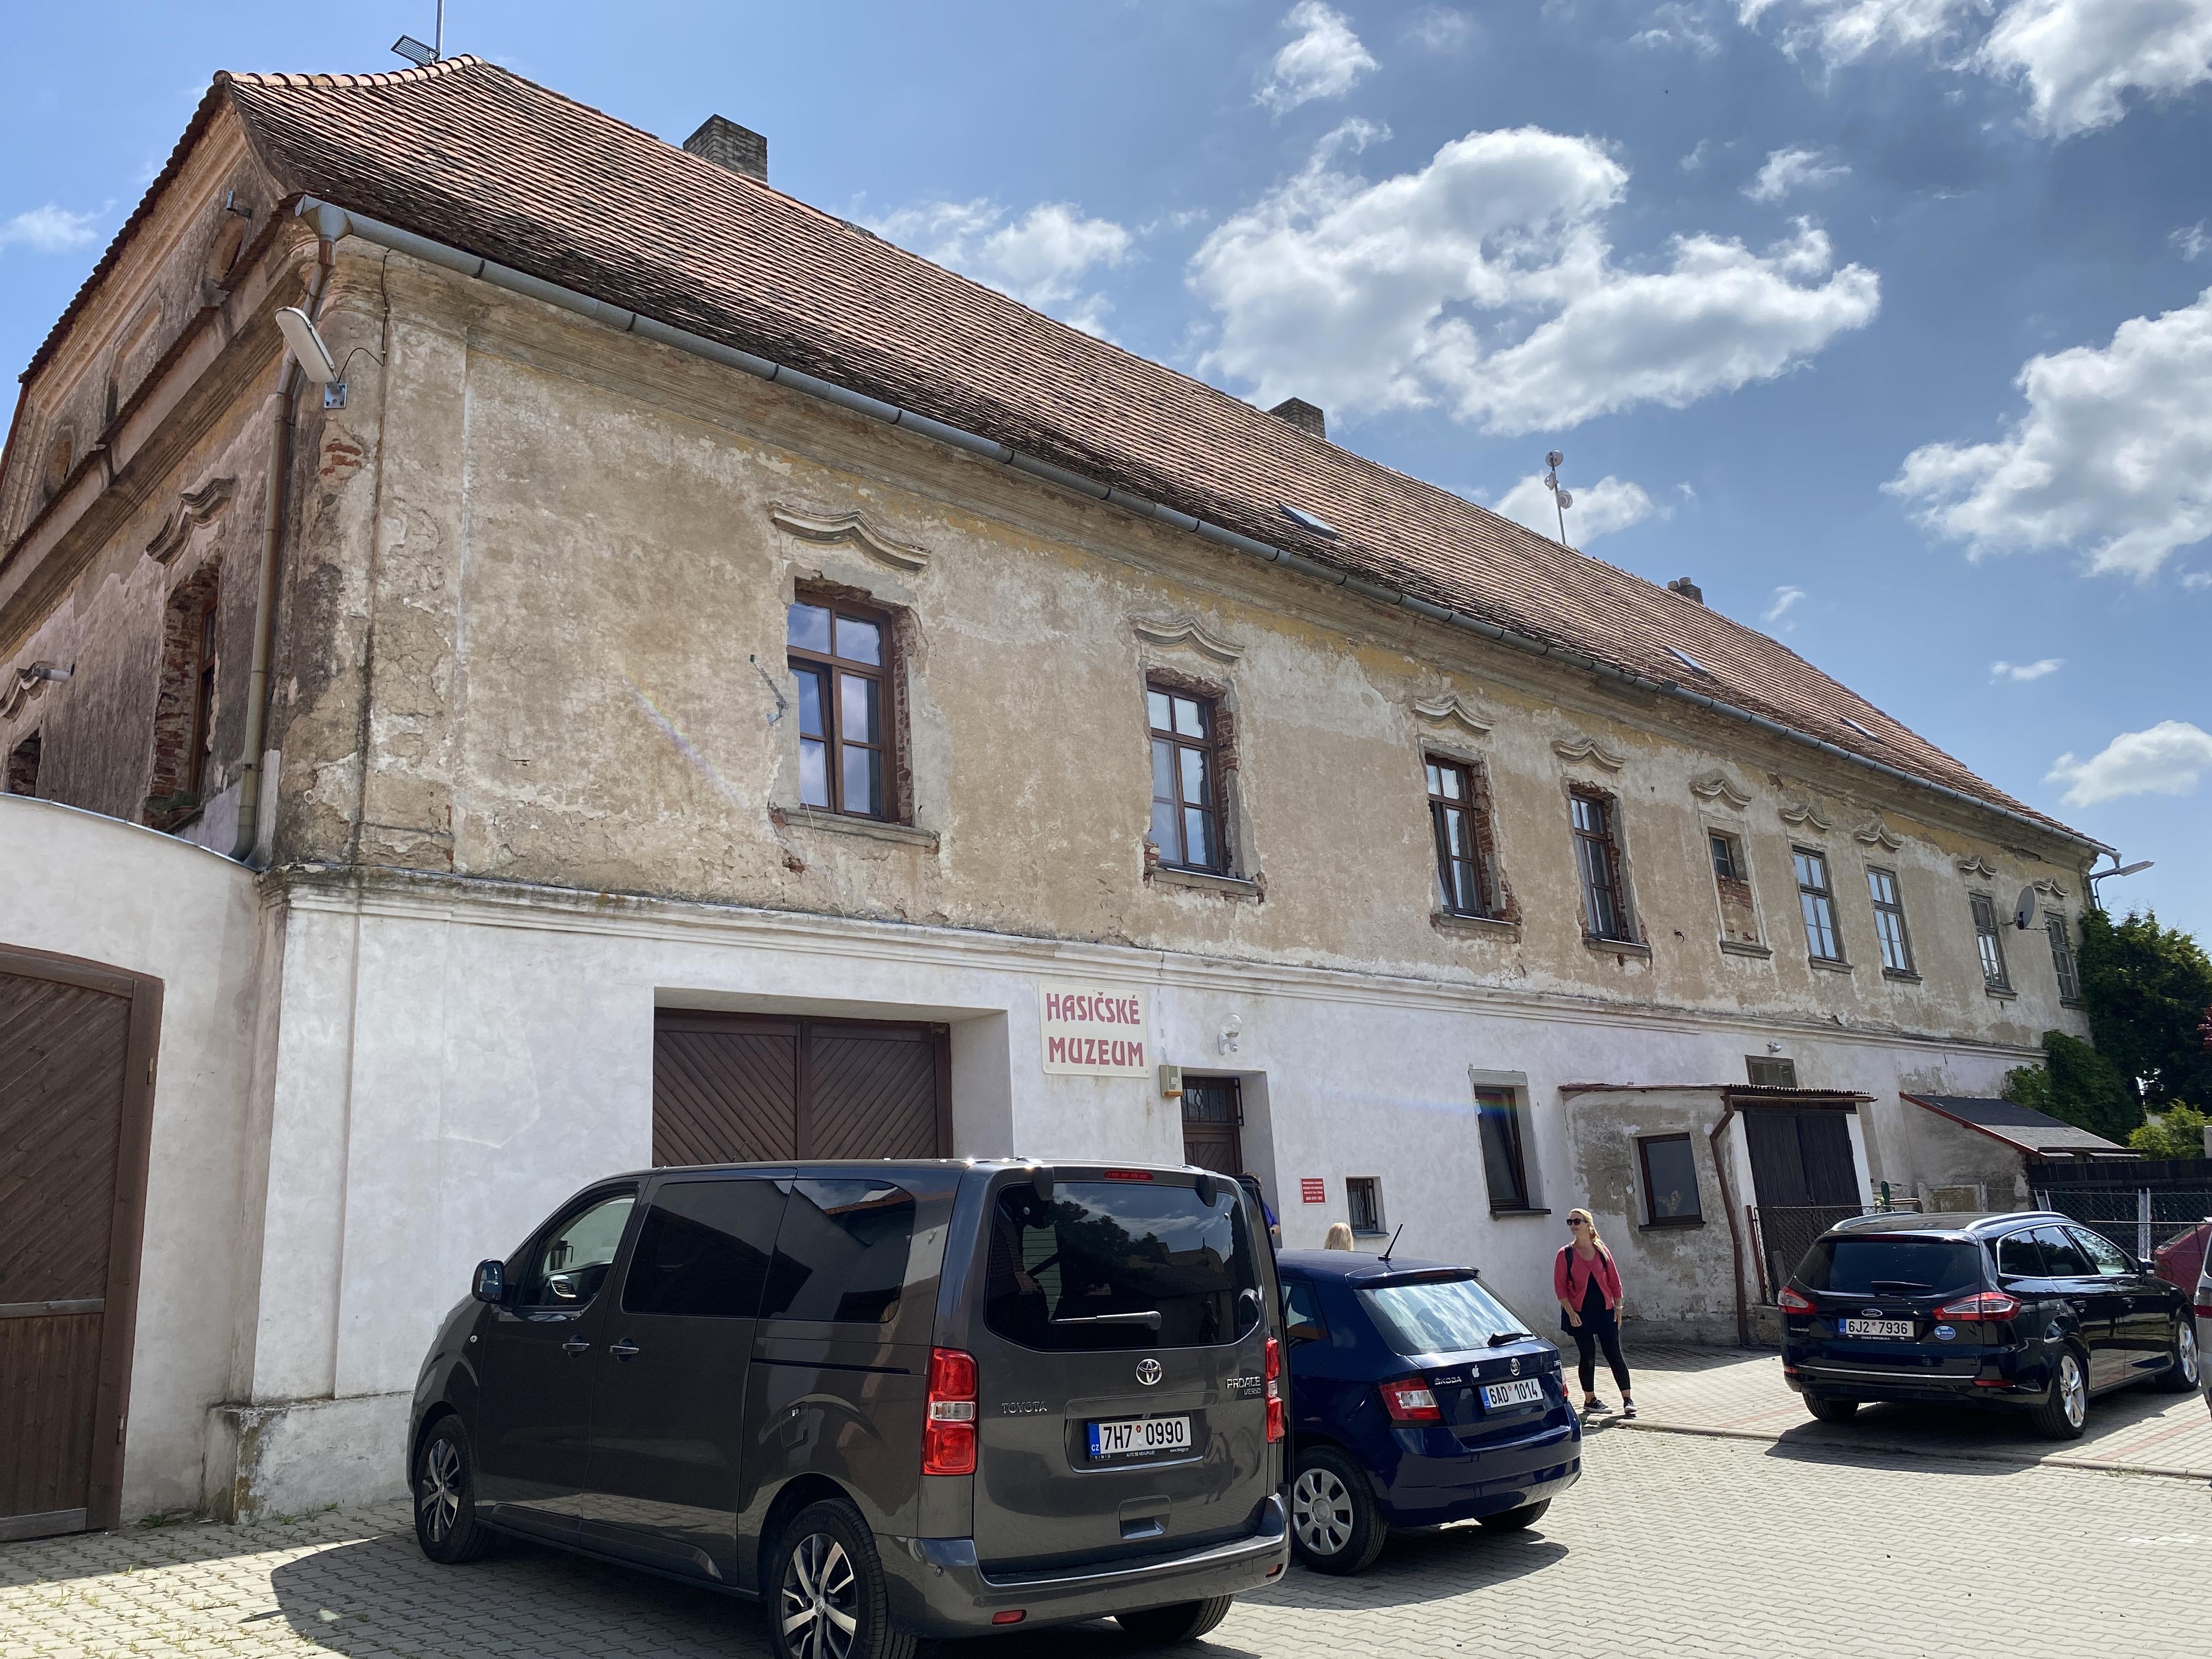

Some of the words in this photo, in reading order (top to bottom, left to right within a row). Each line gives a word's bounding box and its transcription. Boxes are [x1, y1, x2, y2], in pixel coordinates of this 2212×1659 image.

[1046, 992, 1140, 1025] HASIČSKÉ
[1048, 1036, 1144, 1067] MUZEUM
[1848, 1321, 1870, 1333] 6J2
[1879, 1322, 1908, 1334] 7936
[1226, 1376, 1261, 1389] PROACE
[1489, 1386, 1509, 1405] 6AD
[1514, 1381, 1538, 1400] 1014
[1001, 1401, 1047, 1414] TOYOTA
[1103, 1425, 1133, 1450] 7H7
[1145, 1421, 1184, 1446] 0990
